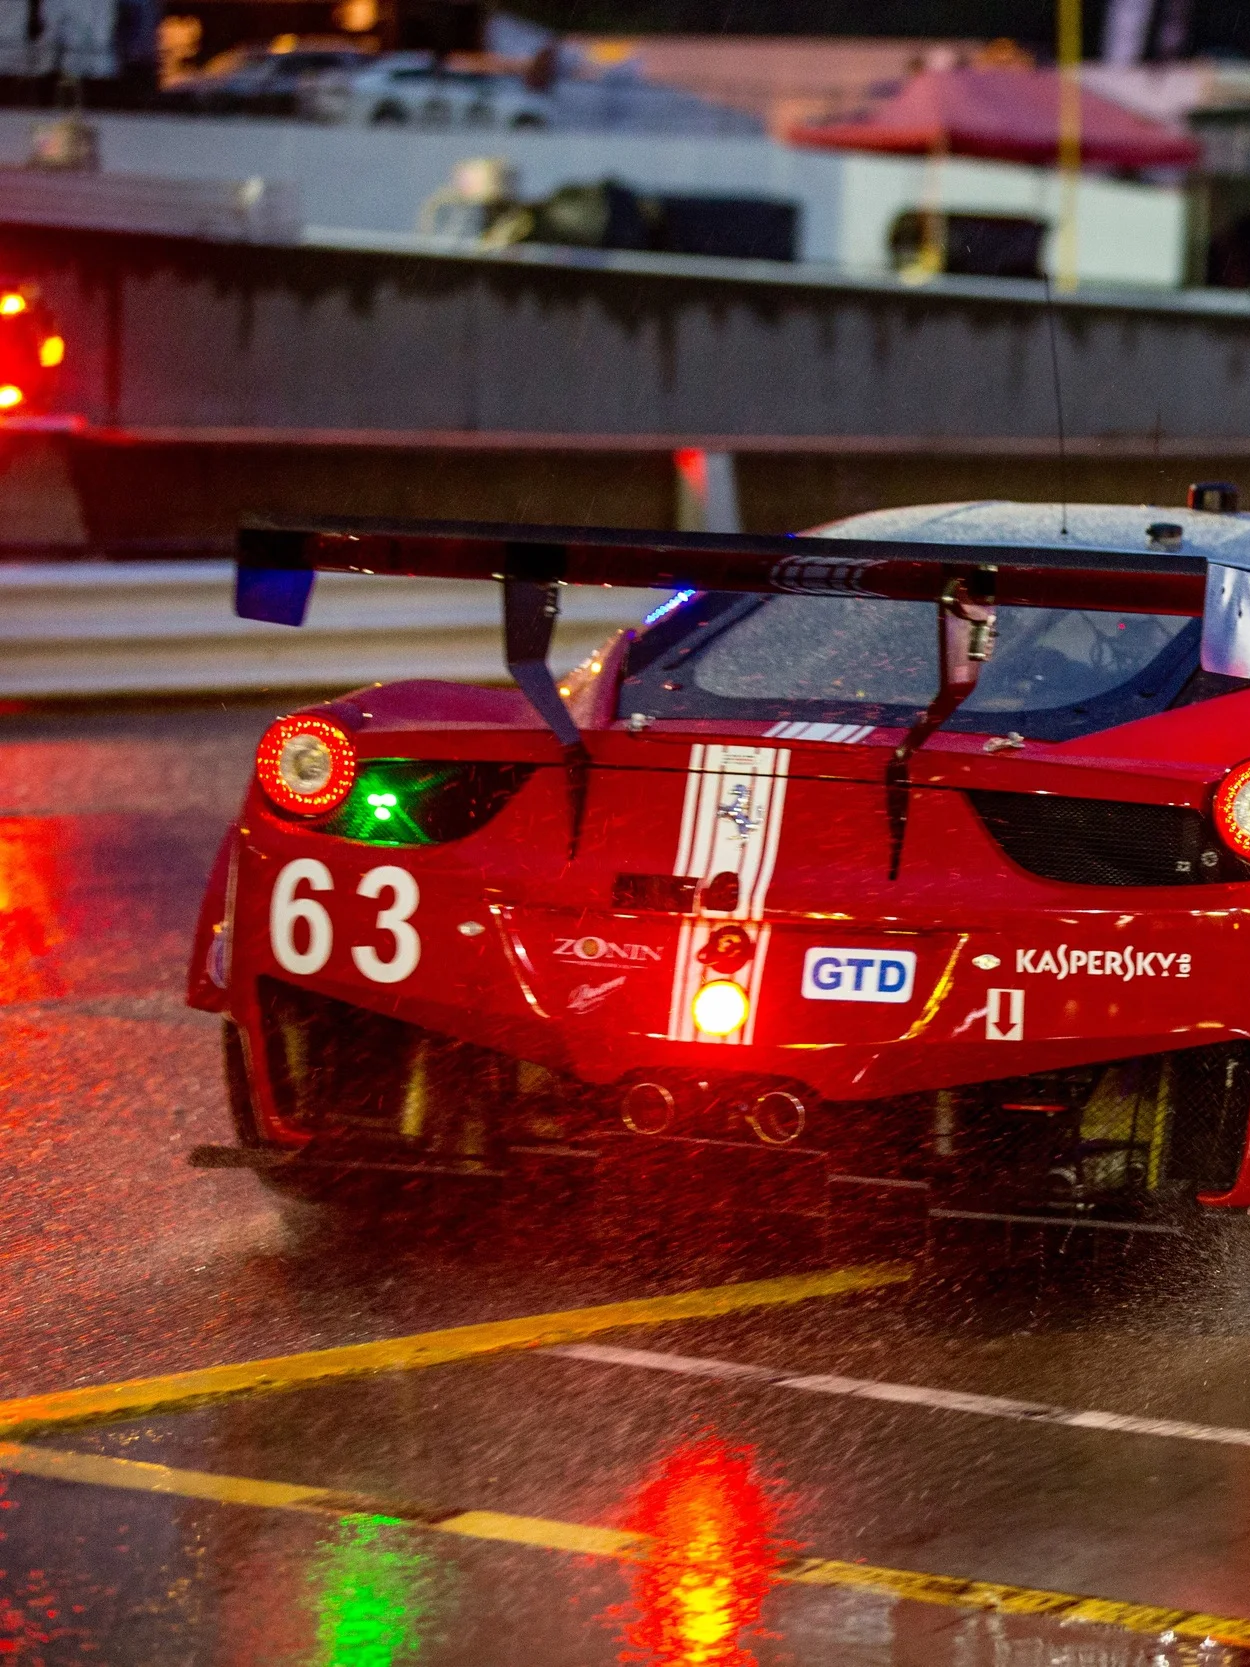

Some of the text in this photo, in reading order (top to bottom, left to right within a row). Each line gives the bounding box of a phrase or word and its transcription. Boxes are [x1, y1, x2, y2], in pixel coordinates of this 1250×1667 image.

[269, 857, 422, 985] 63
[552, 936, 665, 961] ZONIN
[1015, 944, 1176, 983] KASPERSKY
[811, 956, 908, 994] GTD
